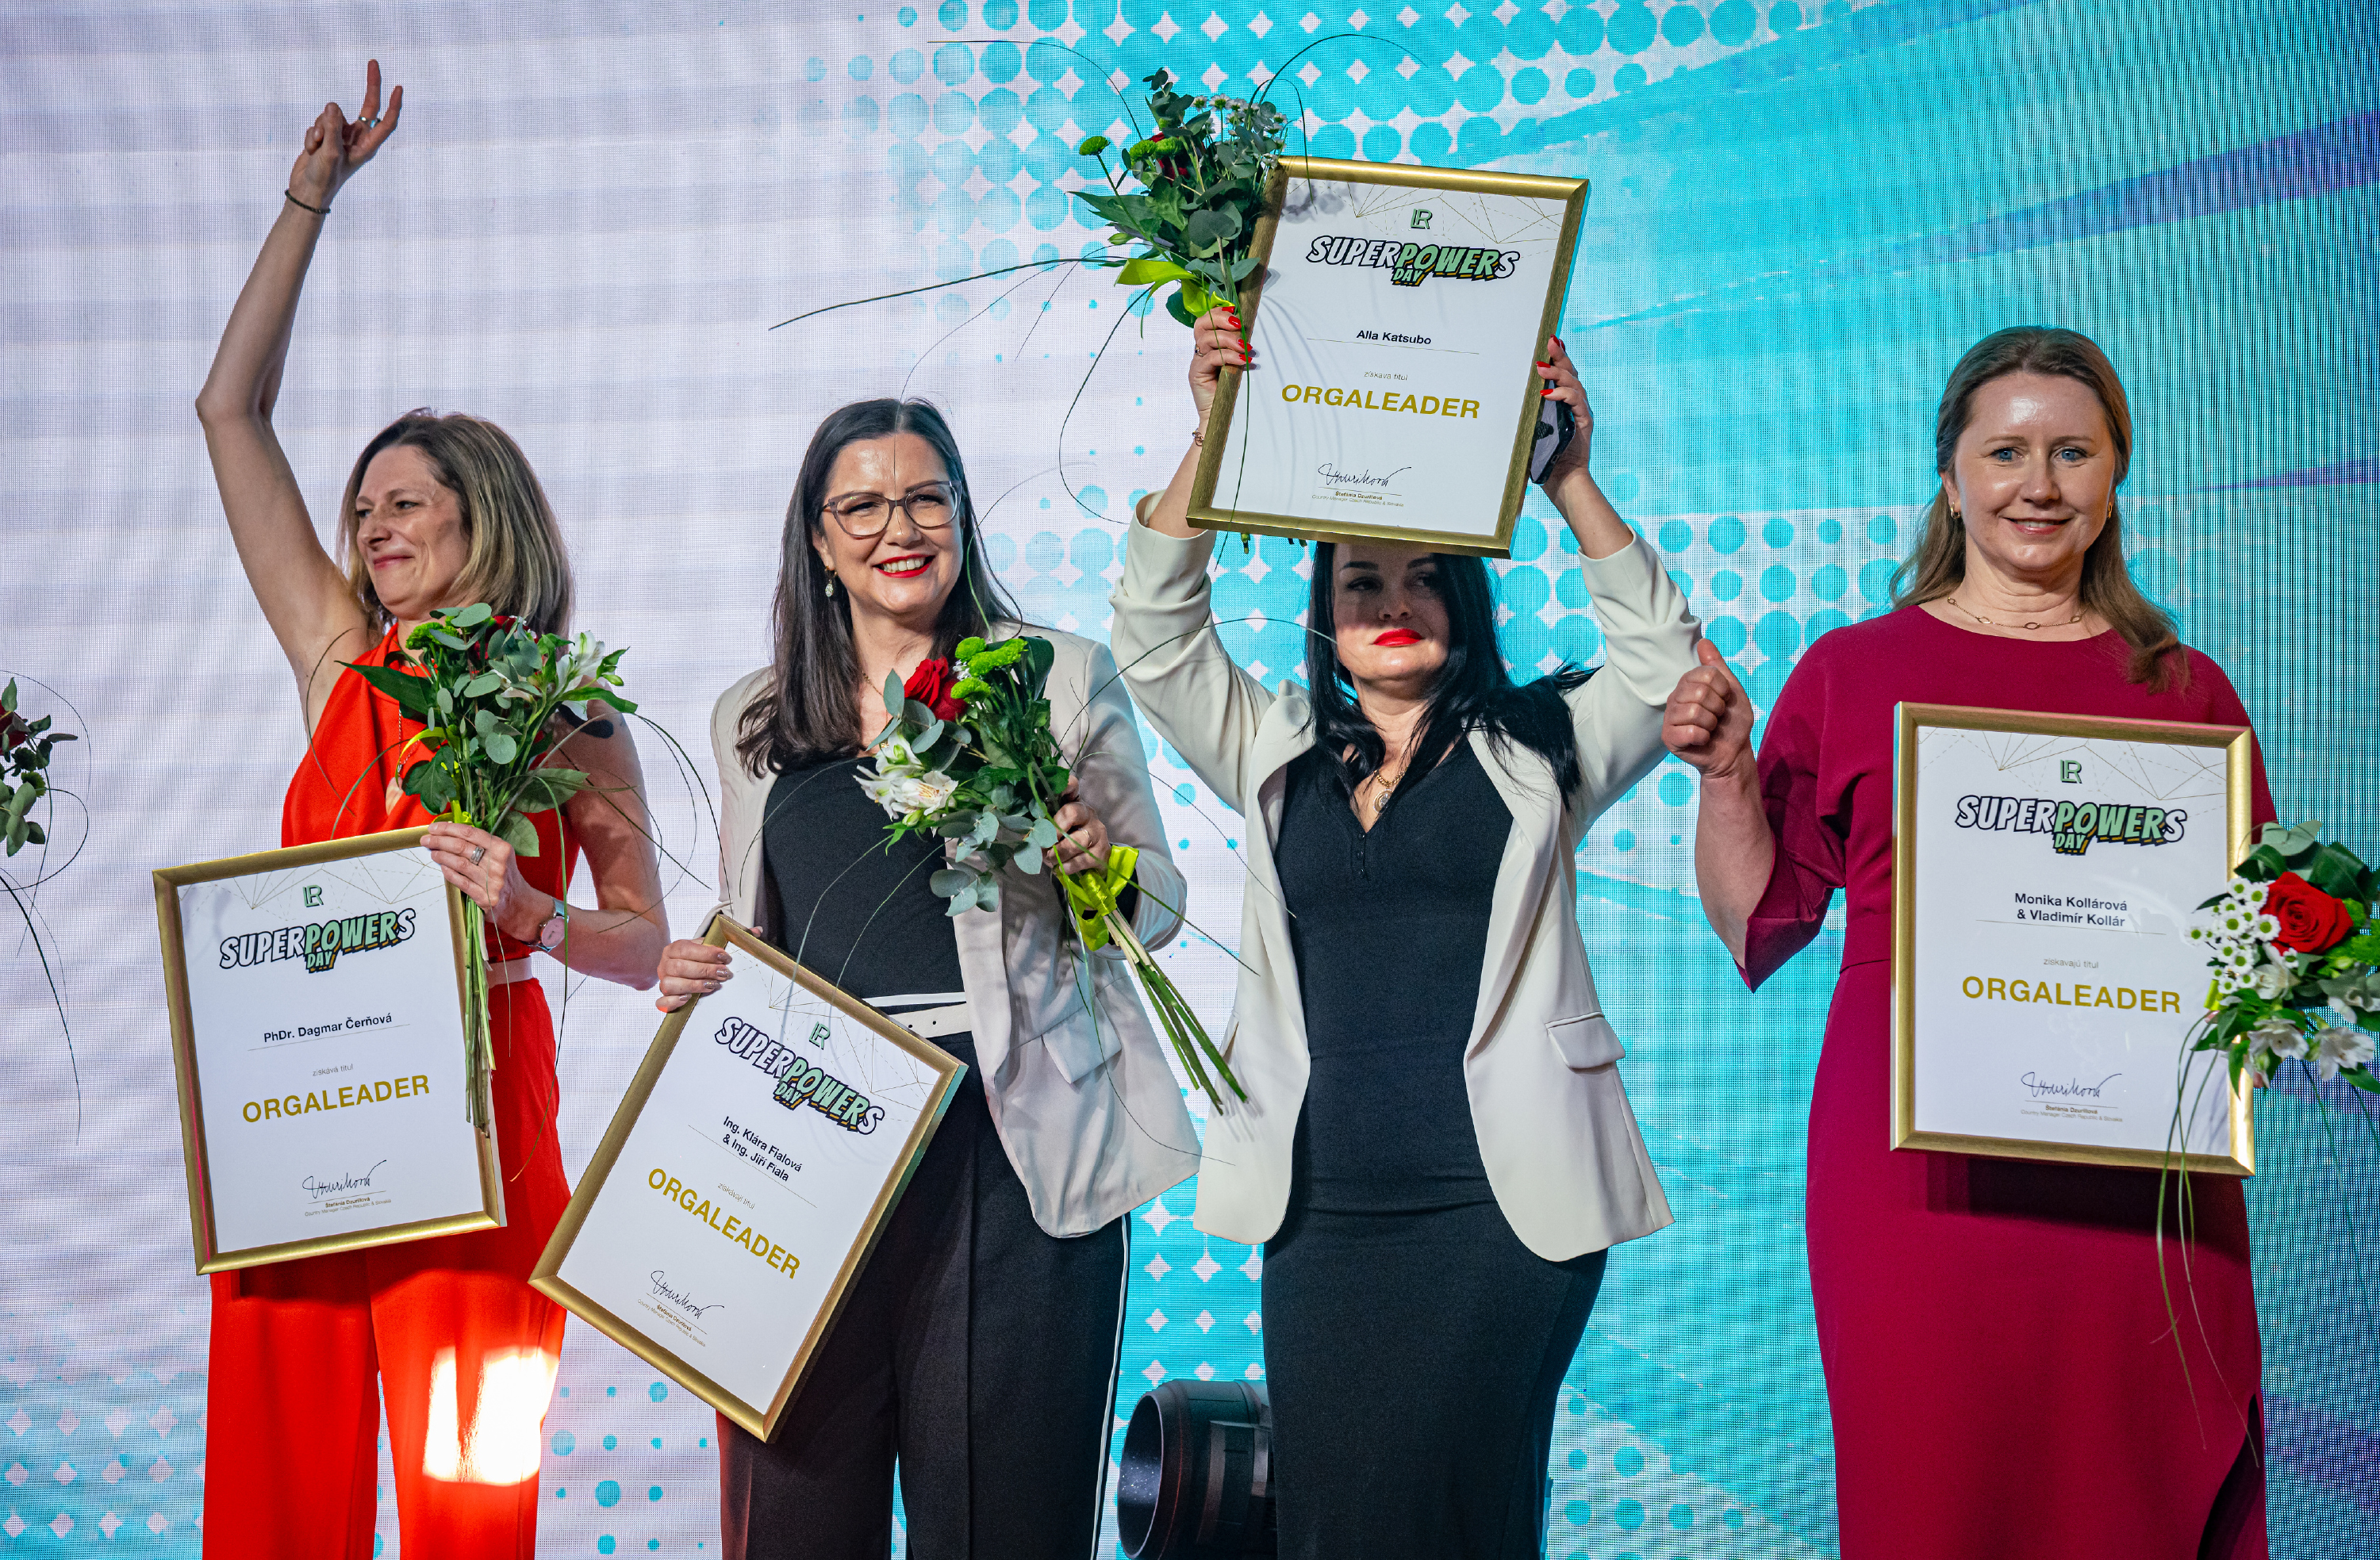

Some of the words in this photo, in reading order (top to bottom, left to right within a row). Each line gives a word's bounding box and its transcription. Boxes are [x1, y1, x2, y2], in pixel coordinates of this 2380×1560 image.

[1411, 209, 1433, 229] LR
[1306, 236, 1520, 282] SUPERPOWERS
[1391, 267, 1427, 286] DAY
[1357, 330, 1378, 340] Alla
[1382, 332, 1431, 345] Katsubo
[1282, 385, 1480, 419] ORGALEADER
[2059, 760, 2082, 784] LR
[1955, 795, 2187, 846] SUPERPOWERS
[2052, 832, 2087, 856] DAY
[302, 885, 324, 907] LR
[2015, 893, 2062, 906] Monika
[2067, 897, 2127, 911] Kollárová
[2017, 909, 2026, 919] &
[2030, 910, 2082, 923] Vladimír
[2087, 914, 2125, 926] Kollár
[220, 908, 416, 969] SUPERPOWERS
[306, 951, 336, 973] DAY
[1963, 975, 2180, 1014] ORGALEADER
[263, 1030, 294, 1042] PhDr.
[298, 1022, 342, 1037] Dagmar
[346, 1013, 392, 1029] Čerňová
[809, 1021, 830, 1050] LR
[340, 1064, 353, 1072] titul
[715, 1017, 885, 1134] SUPERPOWERS
[243, 1075, 429, 1122] ORGALEADER
[773, 1081, 802, 1110] DAY
[723, 1117, 740, 1134] Ing.
[743, 1129, 767, 1151] Klára
[768, 1145, 802, 1172] Fialová
[723, 1134, 731, 1144] &
[731, 1139, 748, 1157] Ing.
[750, 1152, 766, 1167] Jiří
[766, 1162, 789, 1182] Fiala
[743, 1198, 755, 1209] titul
[648, 1168, 800, 1279] ORGALEADER
